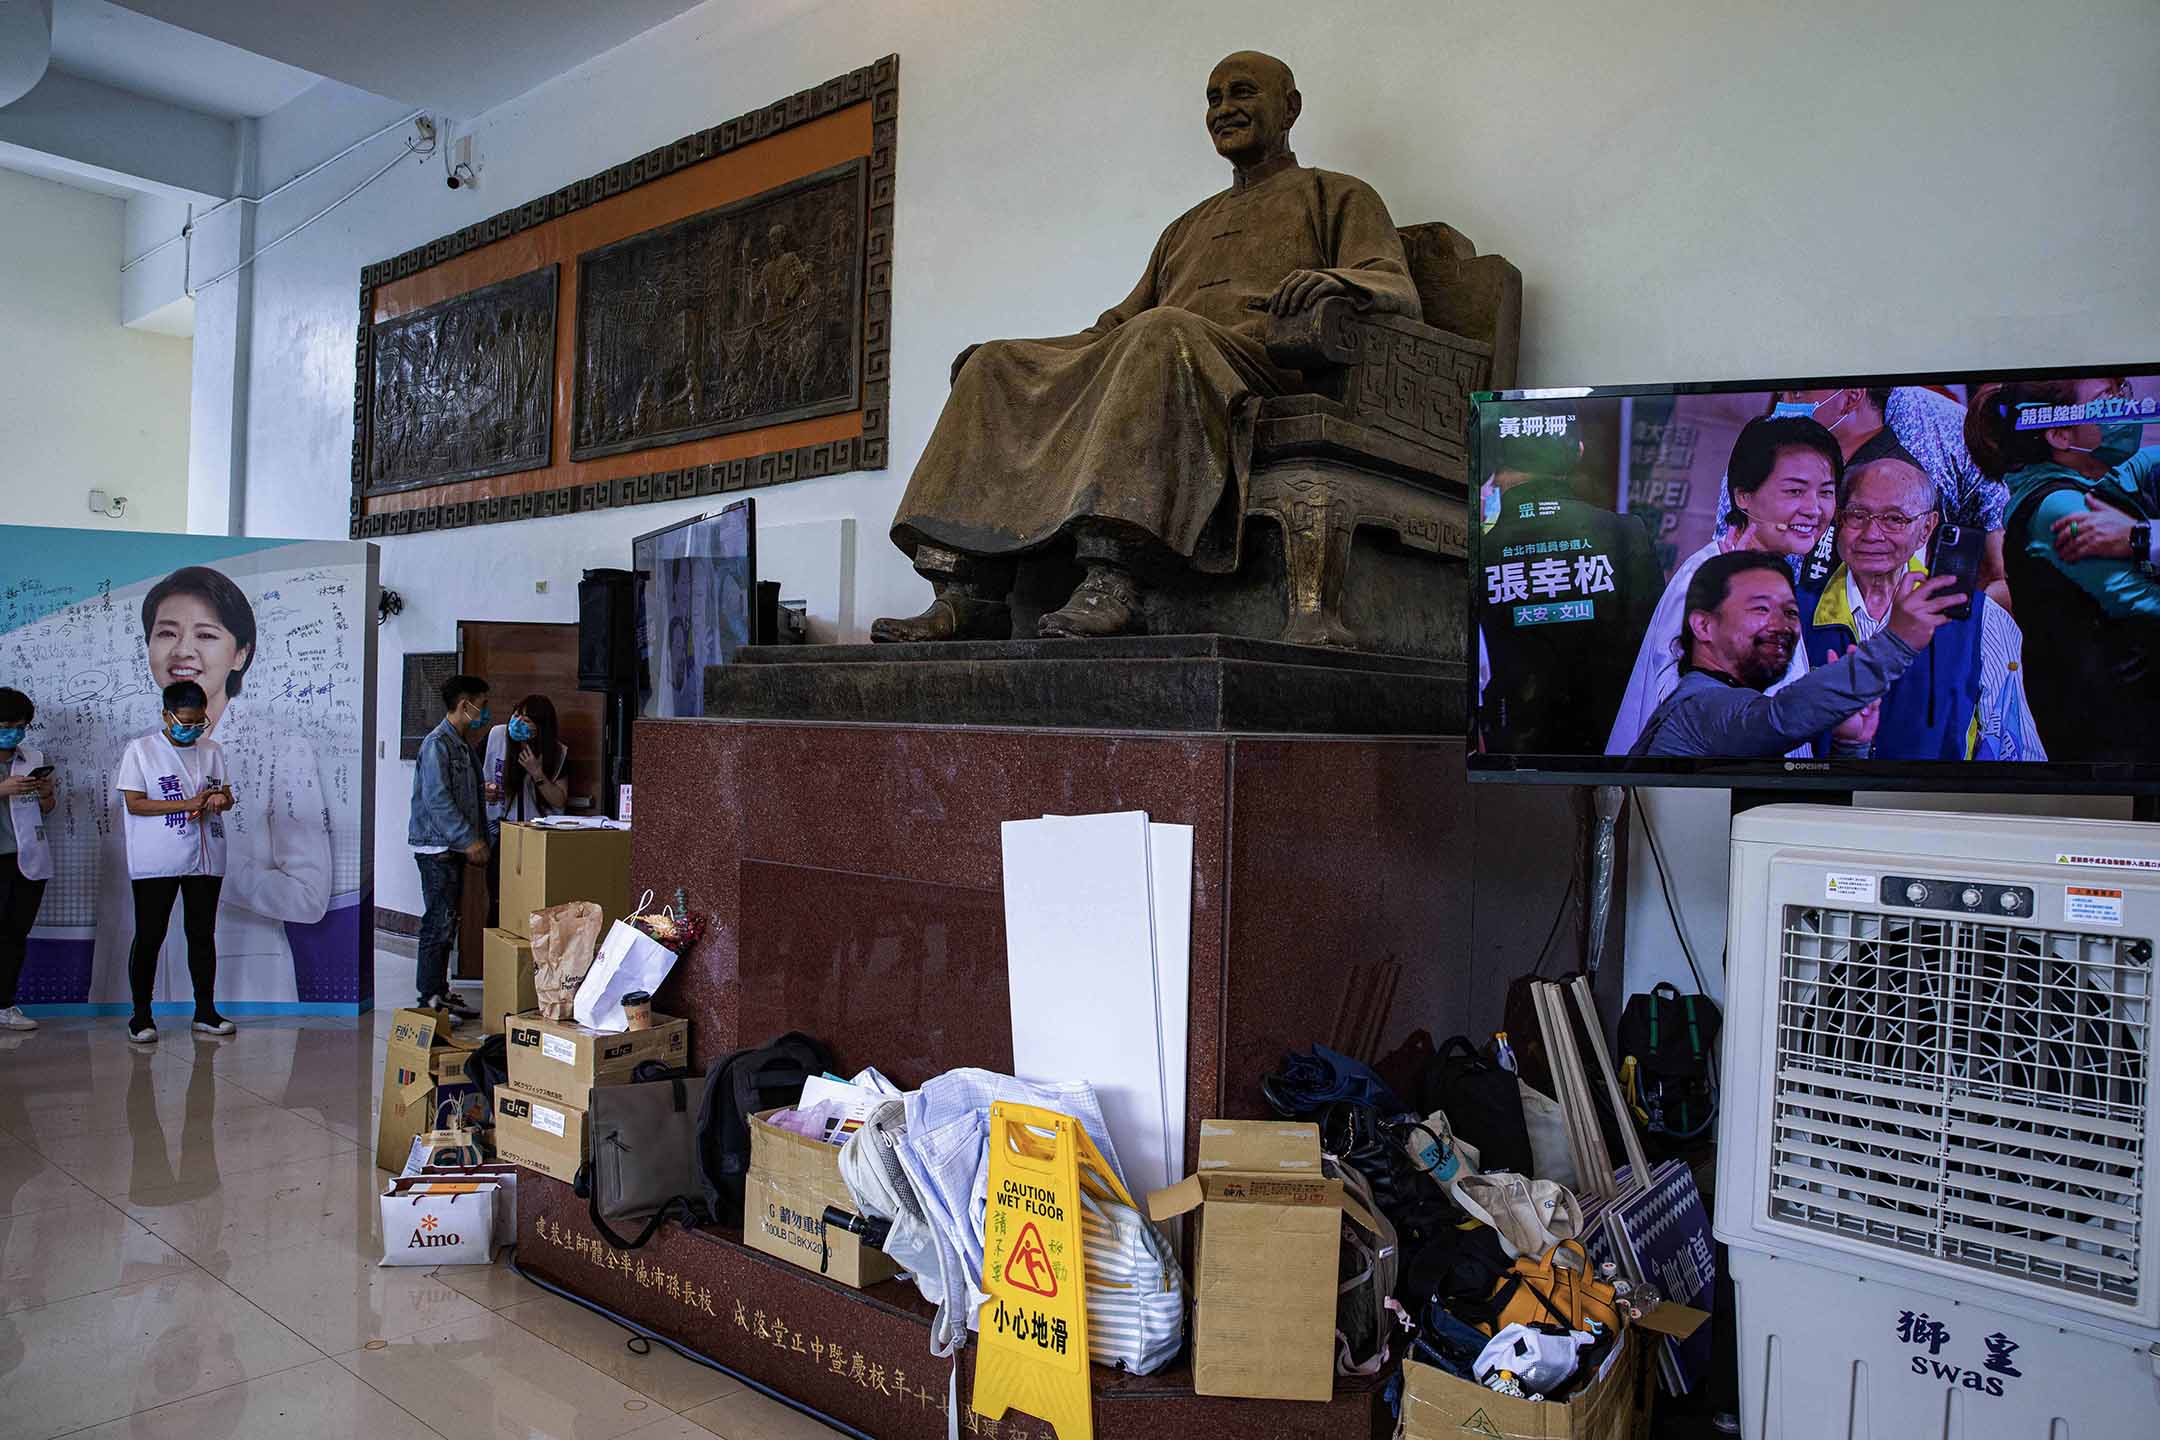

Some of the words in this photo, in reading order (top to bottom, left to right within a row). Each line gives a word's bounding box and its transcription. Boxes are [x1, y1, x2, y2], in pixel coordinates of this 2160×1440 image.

[1499, 415, 1567, 438] 黃珊珊
[1629, 480, 1688, 506] AIPEI
[1503, 538, 1592, 558] 台北市議員參選人
[1485, 554, 1616, 604] 張幸松
[1003, 1180, 1055, 1205] CAUTION
[997, 1192, 1020, 1209] WET
[1025, 1200, 1064, 1222] FLOOR
[408, 1228, 460, 1249] Amo
[993, 1300, 1068, 1355] 小心地滑
[1911, 1355, 2004, 1397] swas
